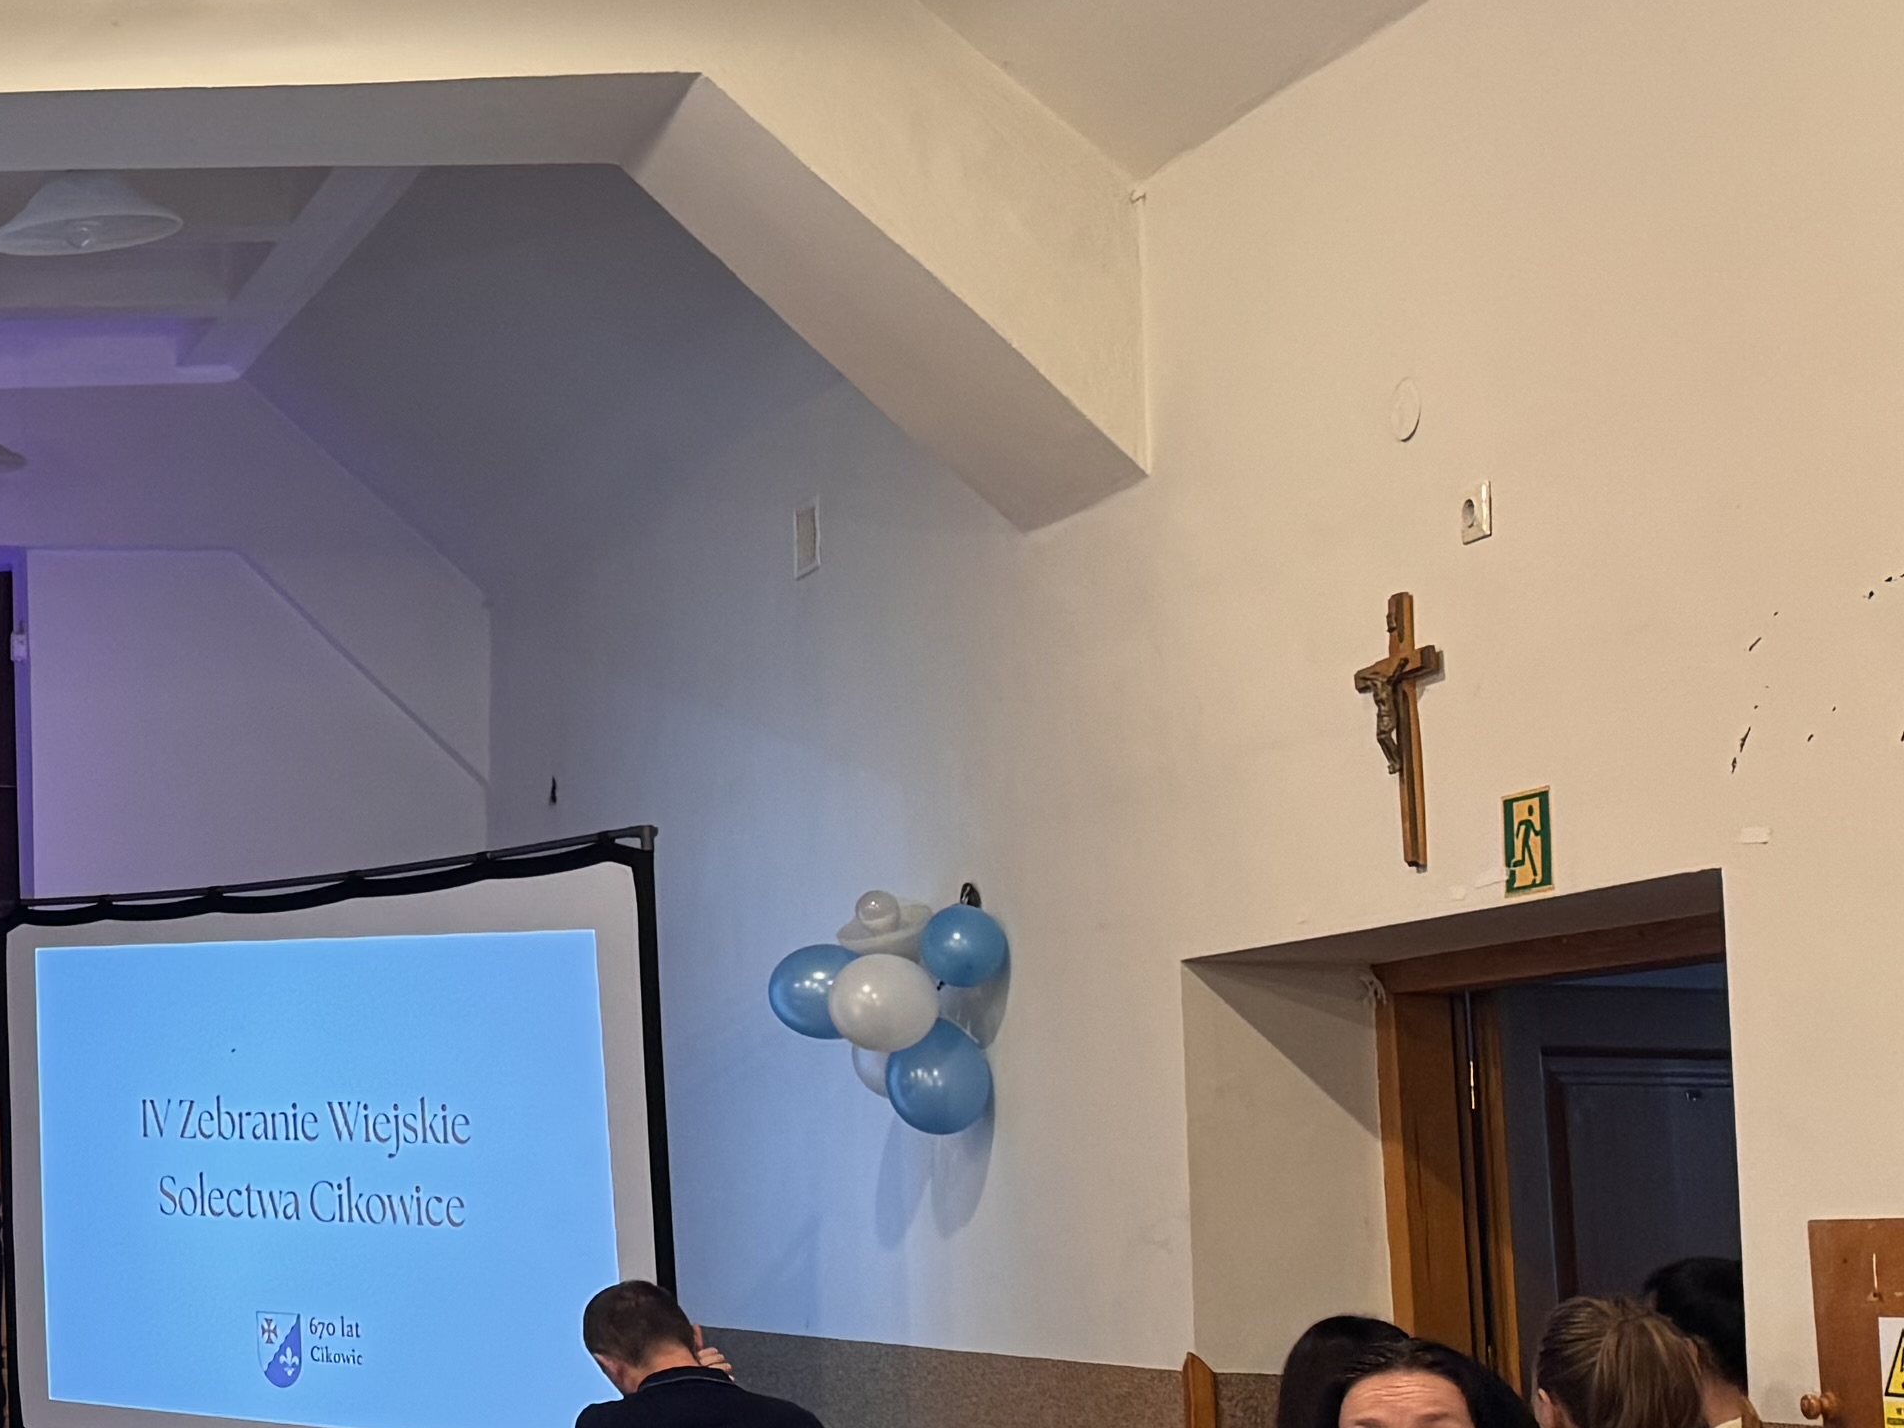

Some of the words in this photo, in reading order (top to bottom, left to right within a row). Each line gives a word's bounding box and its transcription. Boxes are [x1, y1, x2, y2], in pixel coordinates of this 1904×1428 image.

[142, 1099, 171, 1138] IV
[179, 1094, 320, 1142] Zebranie
[327, 1096, 472, 1159] Wiejskie
[309, 1175, 467, 1228] Cikowice
[309, 1316, 336, 1340] 670
[340, 1315, 361, 1338] lat
[310, 1345, 364, 1366] Cikowic
